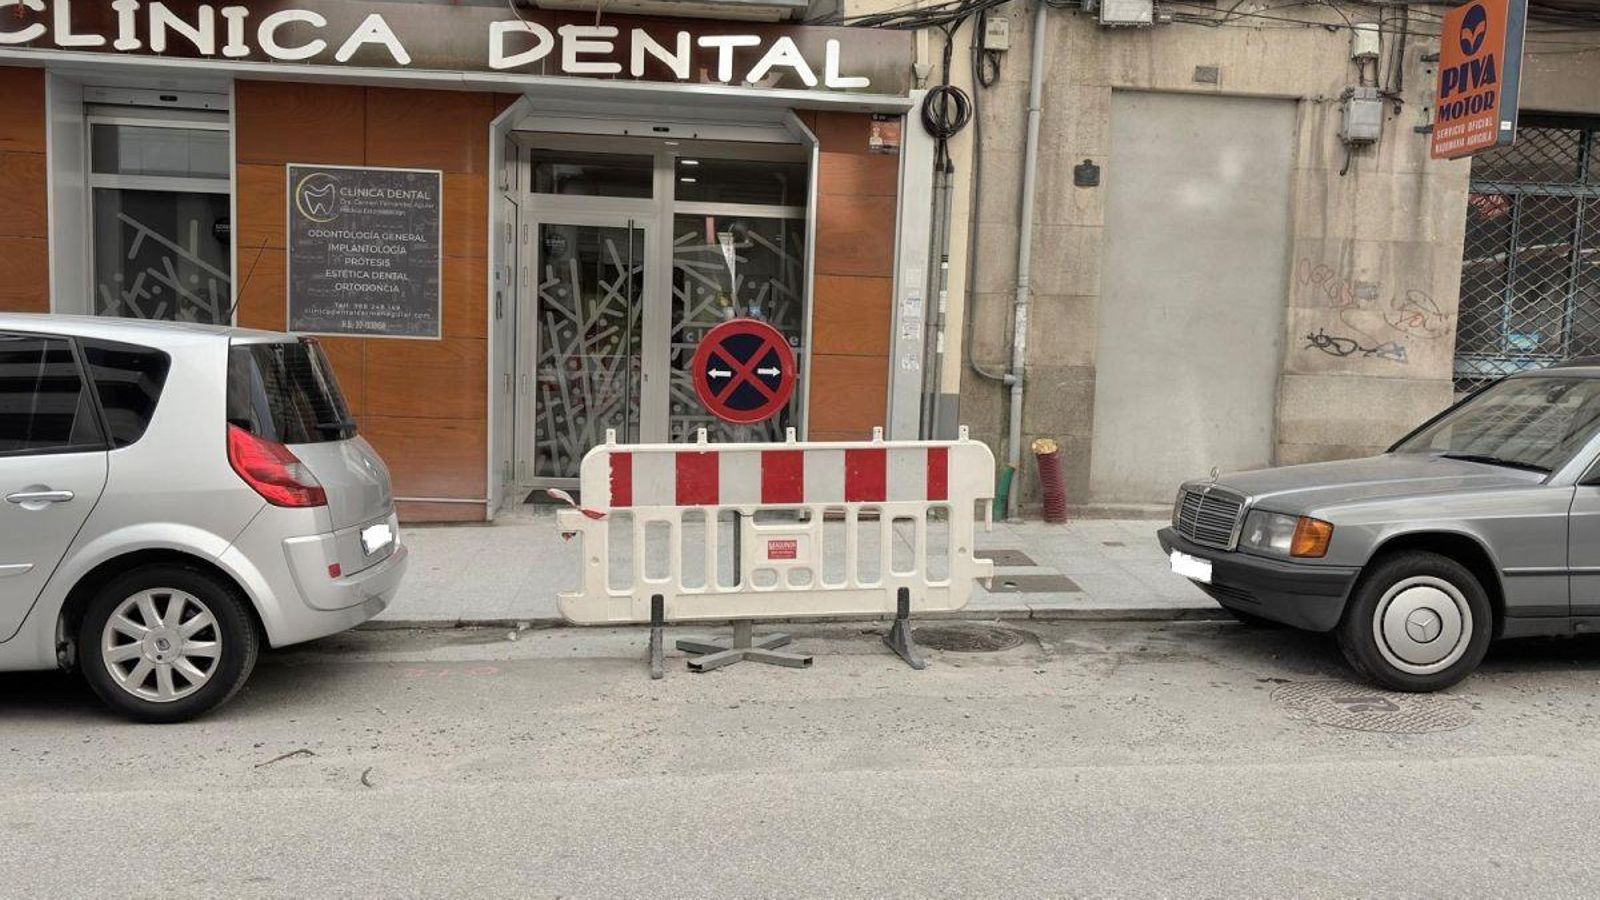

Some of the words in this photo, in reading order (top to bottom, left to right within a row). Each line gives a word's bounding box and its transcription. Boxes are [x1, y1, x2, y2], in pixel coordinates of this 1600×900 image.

[489, 20, 870, 88] DENTAL
[1441, 53, 1496, 98] PIVA
[1438, 90, 1495, 123] MOTOR
[1436, 123, 1465, 141] SERVICIO
[1467, 116, 1493, 134] OFICIAL
[387, 188, 432, 201] DENTAL
[382, 232, 427, 242] GENERAL
[371, 270, 409, 281] DENTAL
[334, 282, 401, 293] ORTODONCIA
